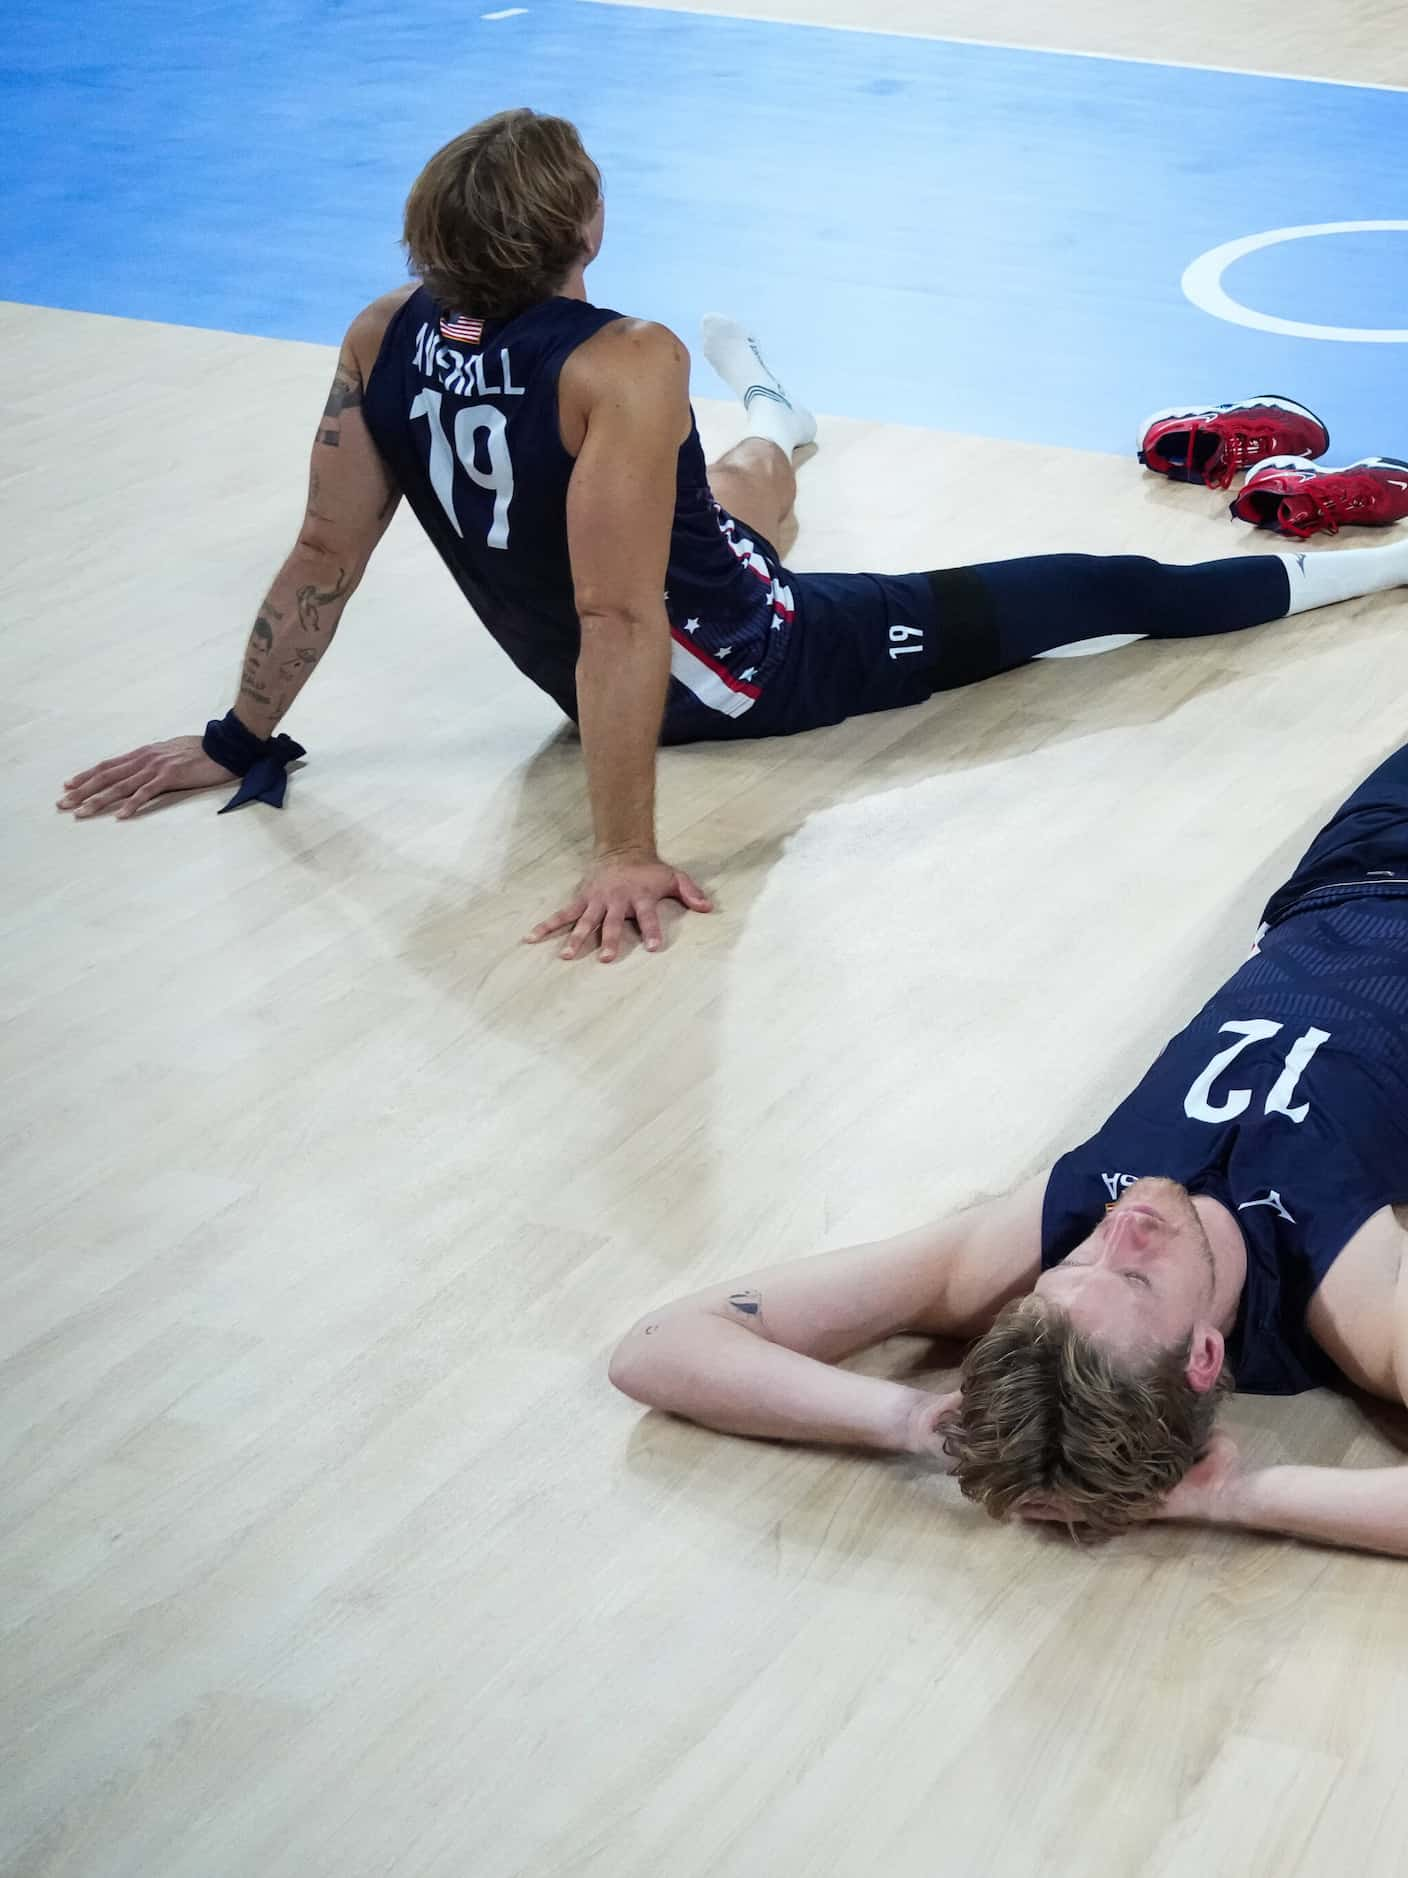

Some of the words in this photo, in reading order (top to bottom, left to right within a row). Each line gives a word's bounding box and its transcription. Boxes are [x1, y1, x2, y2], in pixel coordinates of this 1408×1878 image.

[409, 388, 514, 550] 19
[888, 625, 924, 660] 19
[1183, 1018, 1332, 1124] 12
[1101, 1172, 1139, 1201] SA
